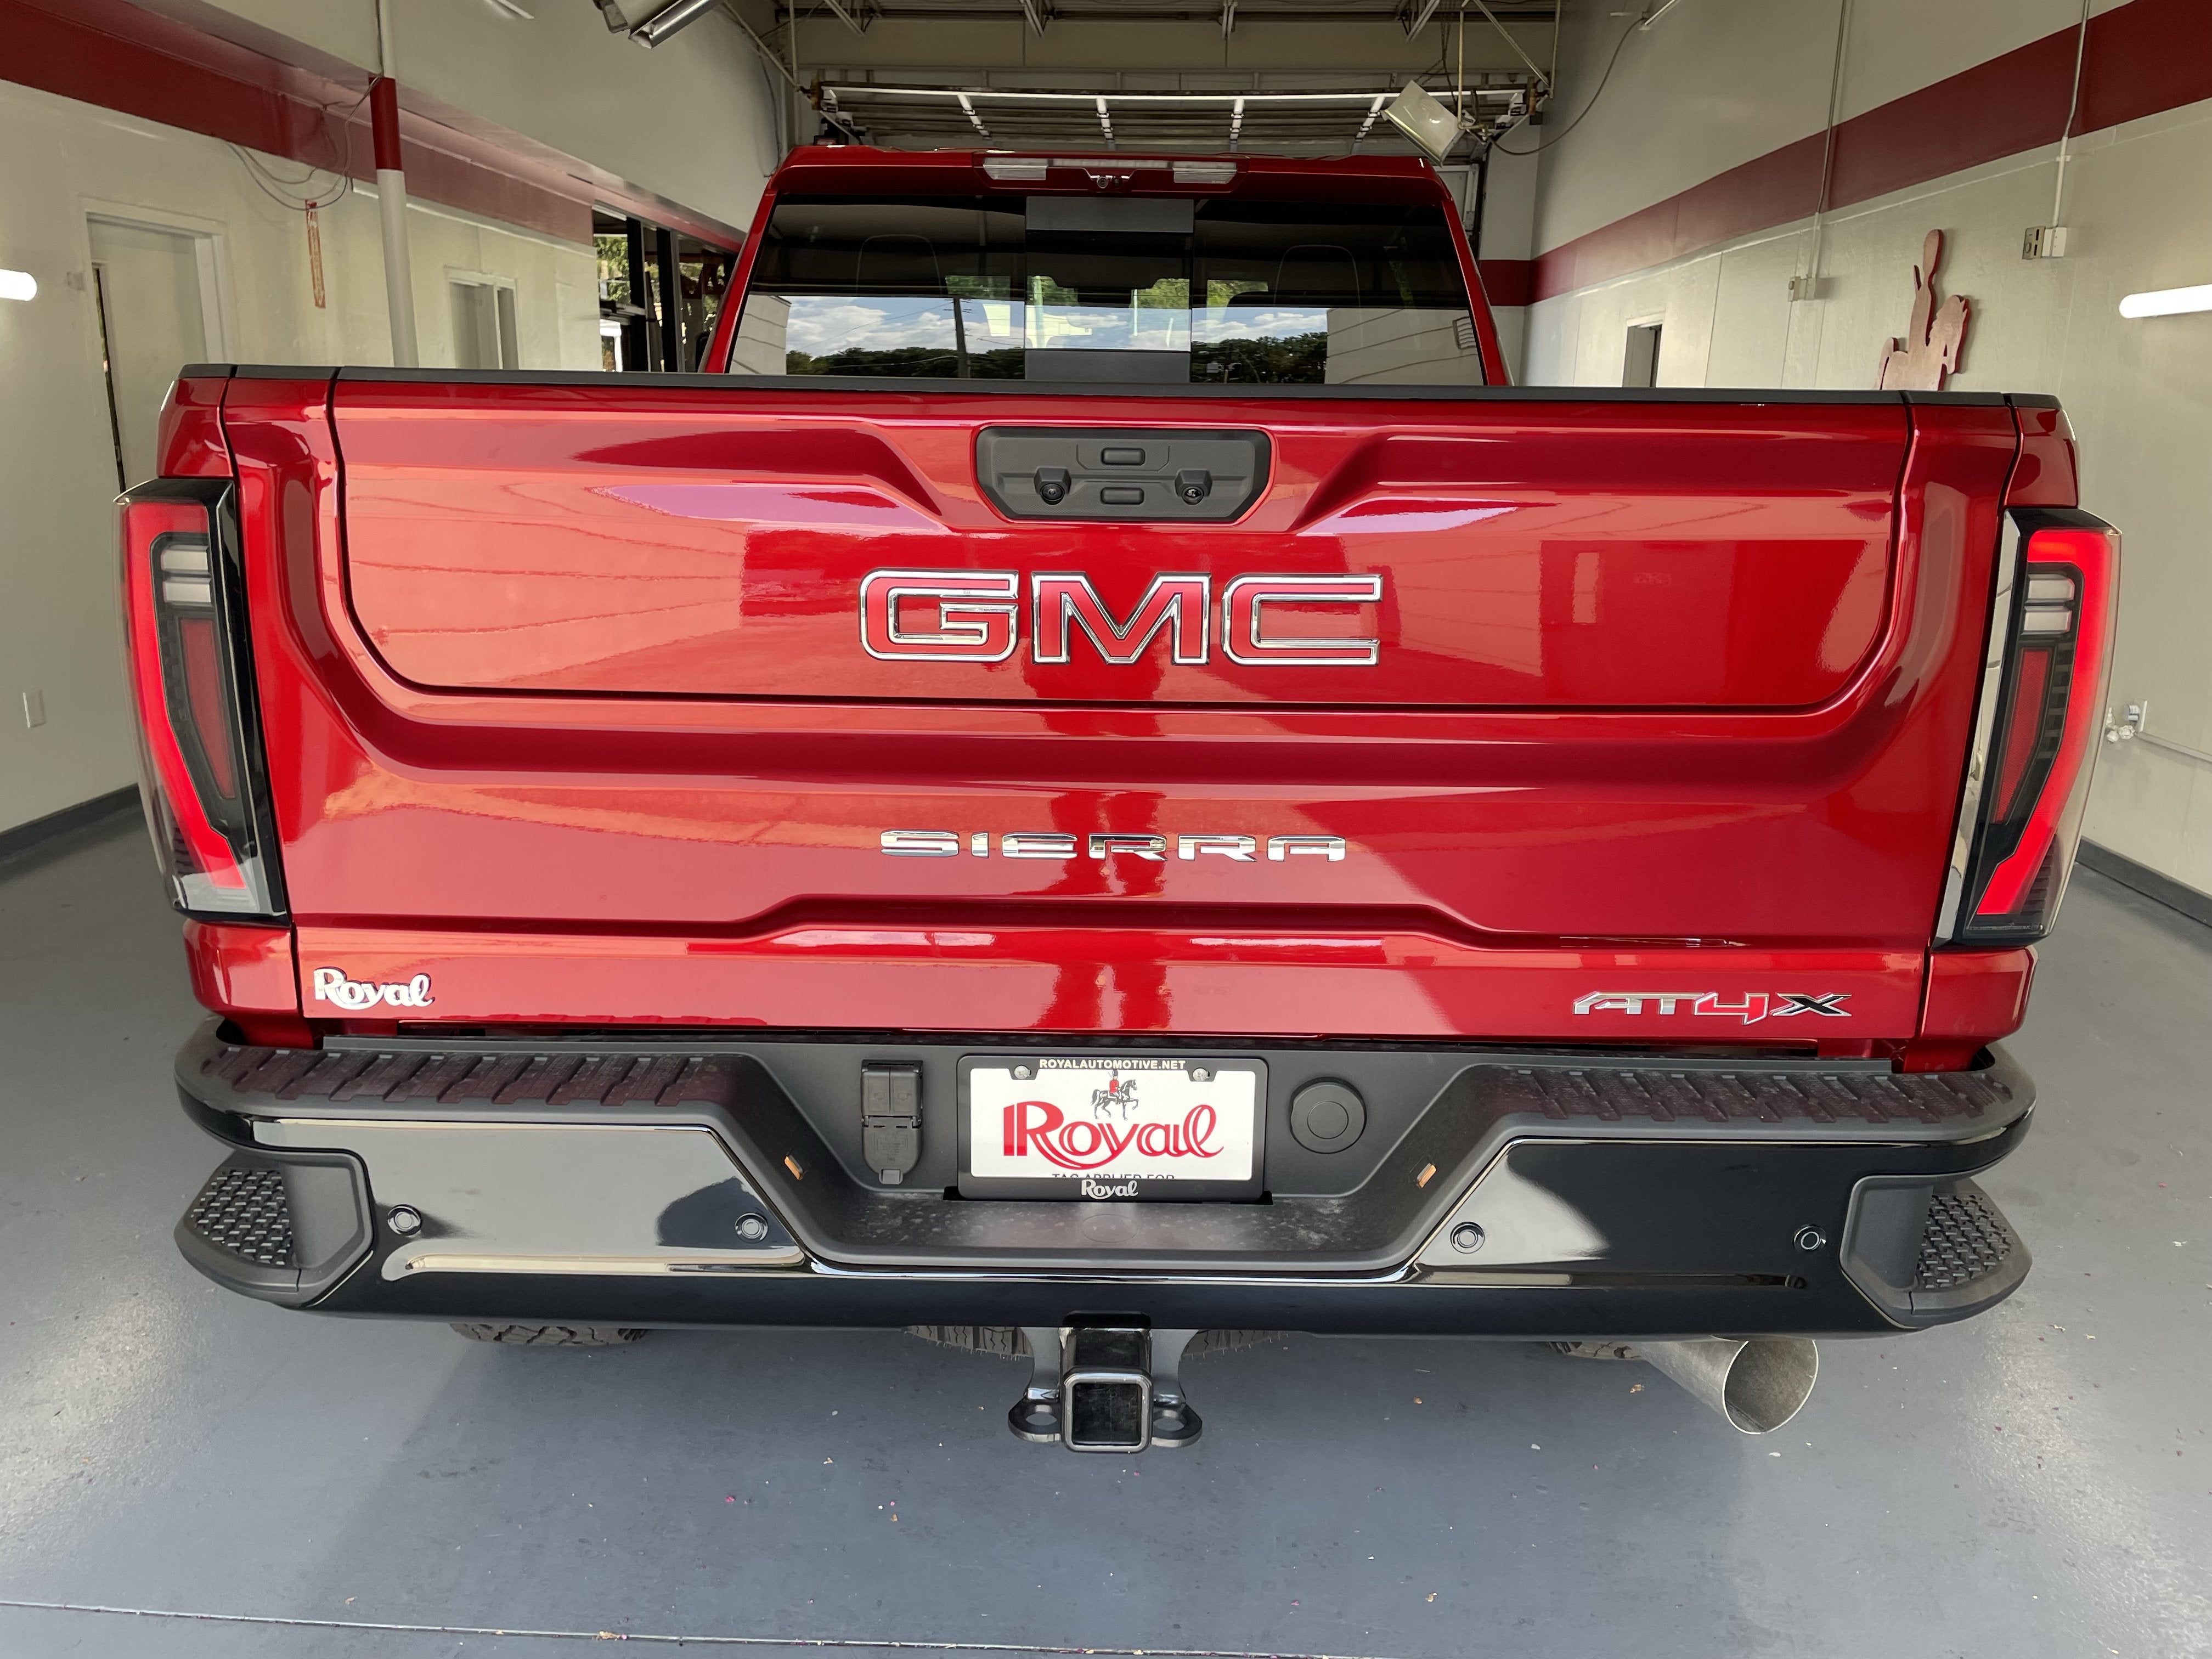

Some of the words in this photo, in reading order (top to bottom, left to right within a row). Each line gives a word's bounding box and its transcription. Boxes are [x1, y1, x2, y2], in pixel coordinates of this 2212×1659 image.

[859, 568, 1383, 666] GMC
[881, 830, 1346, 862] SIERRA
[313, 966, 436, 1010] Royal
[1572, 991, 1853, 1025] AT4X
[1039, 1059, 1186, 1070] ROYALAUTOMOTIVE.NET
[1003, 1101, 1224, 1170] Royal
[1081, 1178, 1139, 1200] Royal
